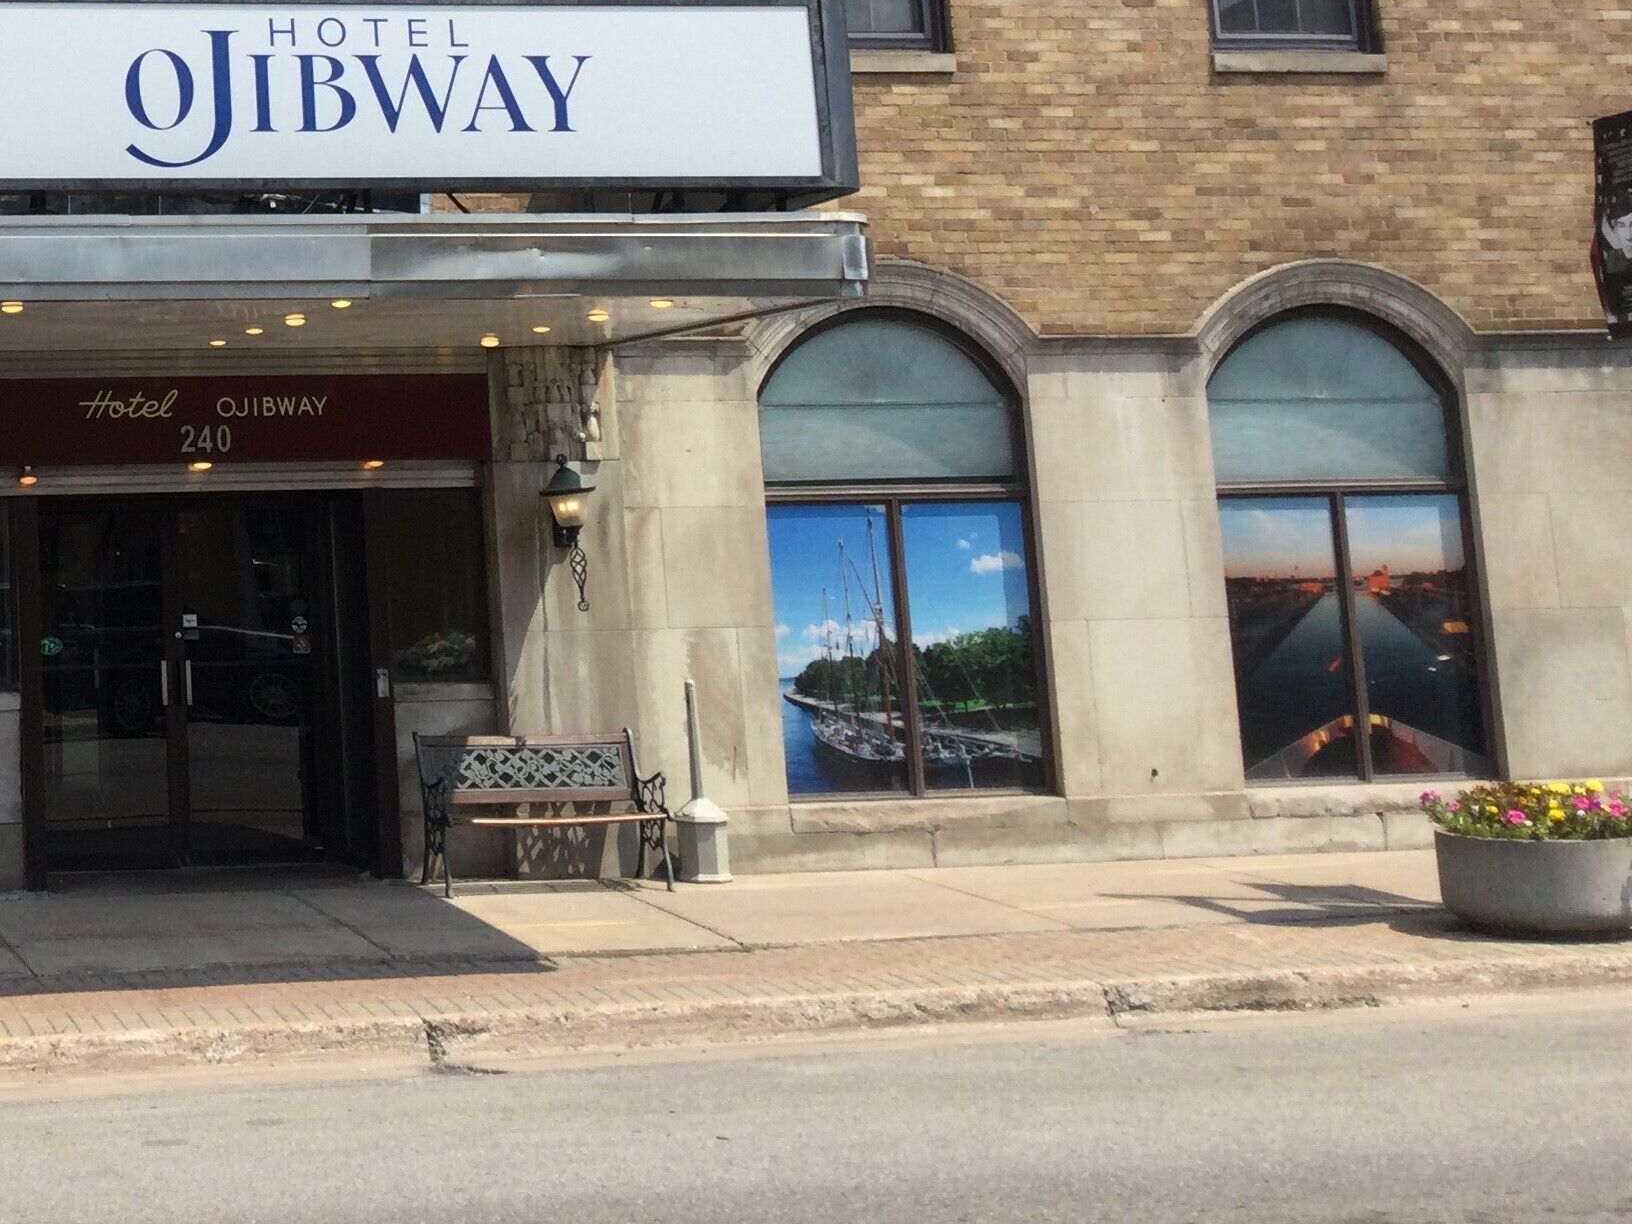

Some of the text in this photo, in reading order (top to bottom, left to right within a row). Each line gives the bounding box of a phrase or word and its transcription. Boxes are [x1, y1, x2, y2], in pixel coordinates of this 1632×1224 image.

[268, 17, 469, 48] HOTEL
[124, 29, 593, 168] OJIBWAY
[79, 389, 328, 420] Hotel OJIBWAY
[179, 424, 232, 453] 240
